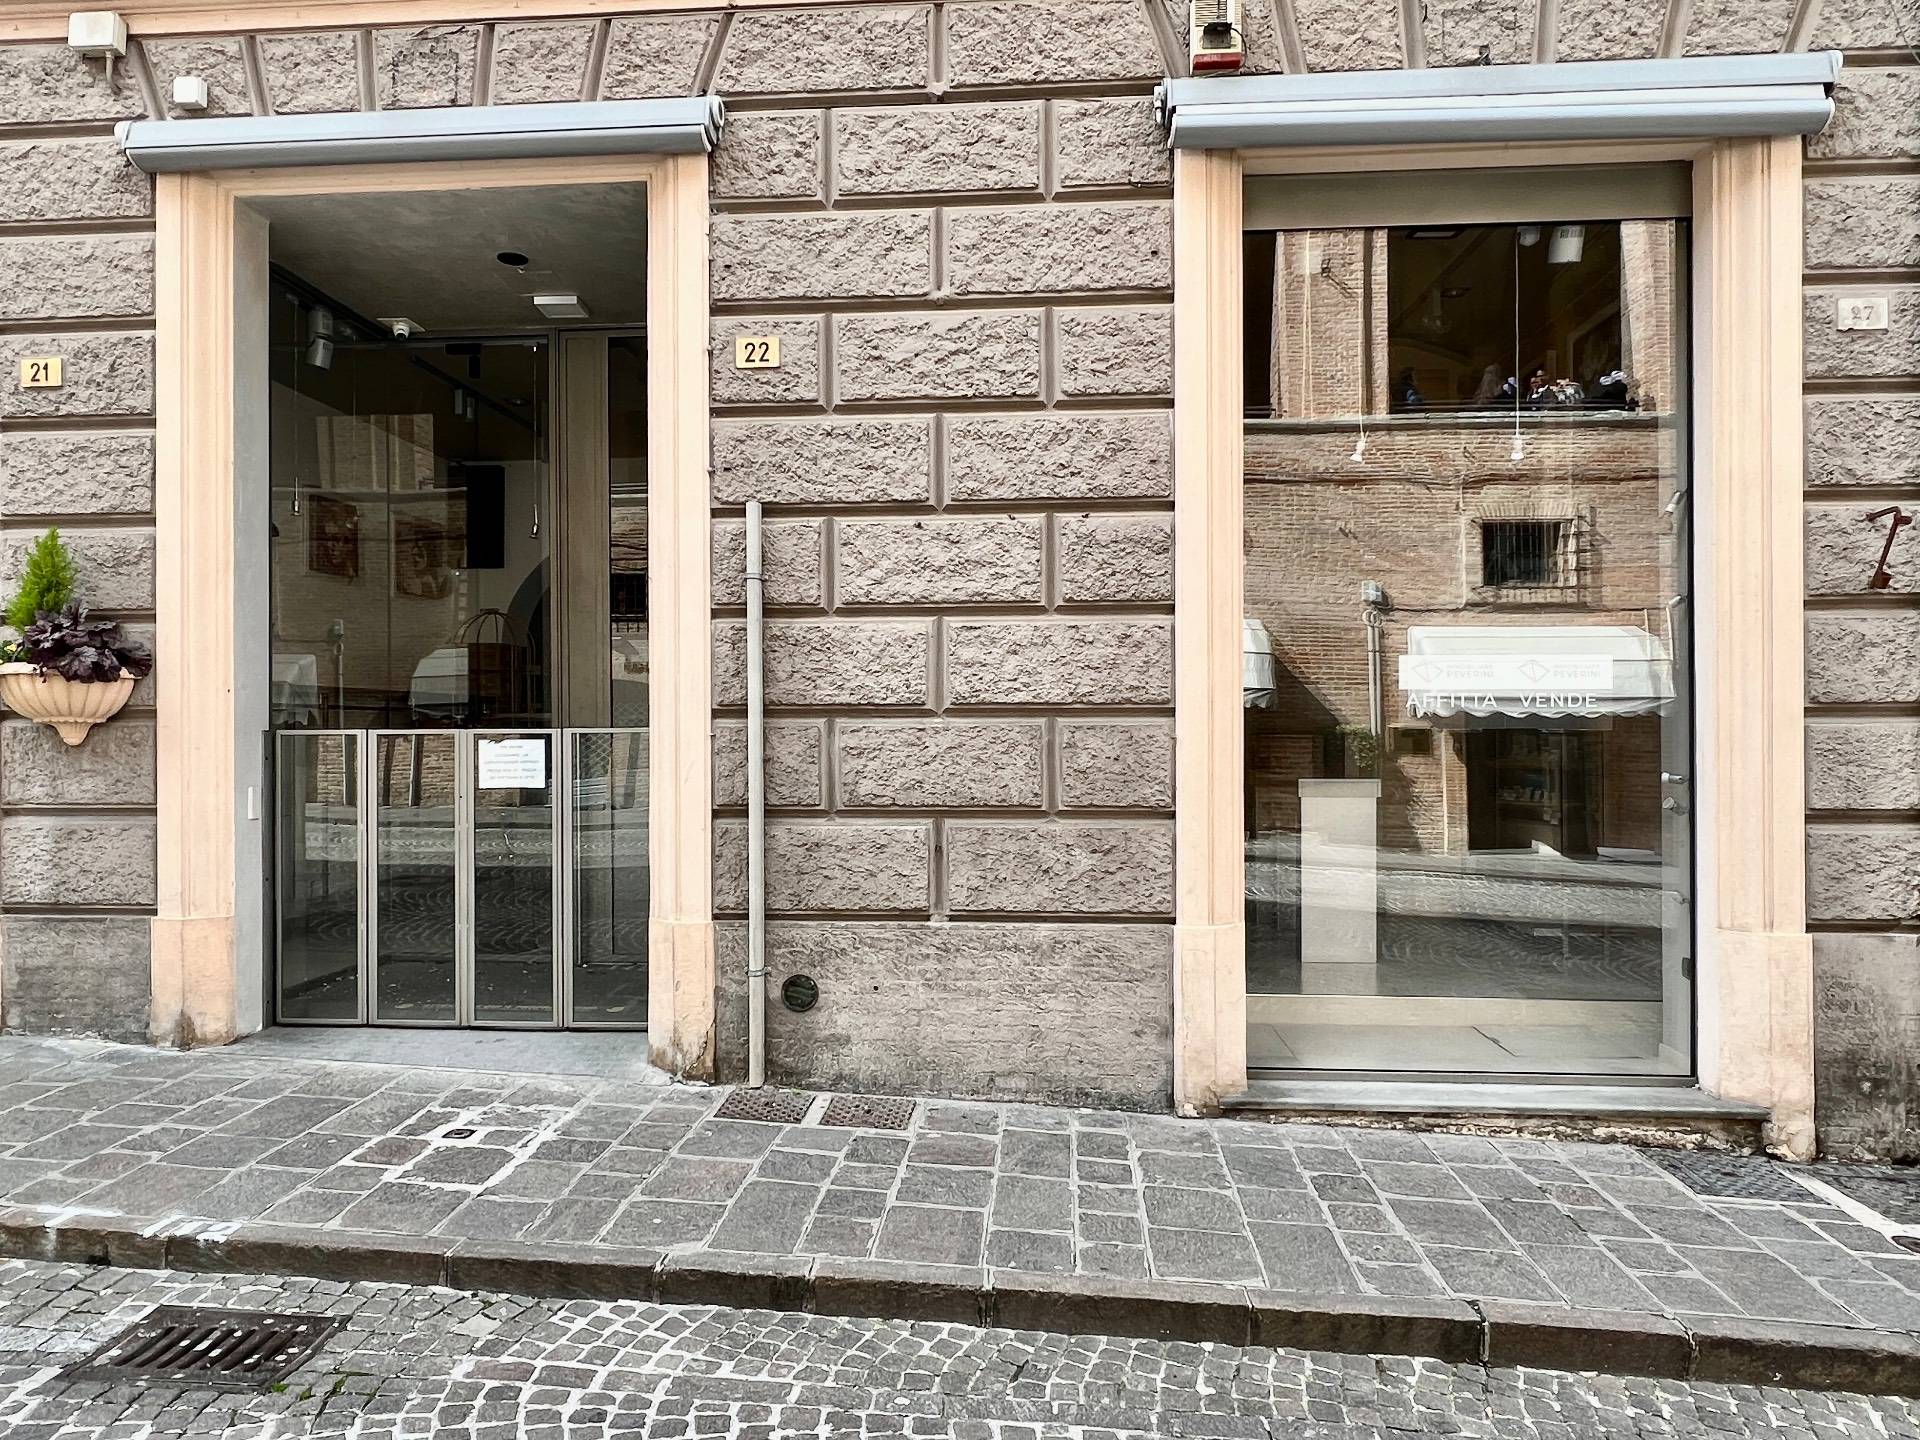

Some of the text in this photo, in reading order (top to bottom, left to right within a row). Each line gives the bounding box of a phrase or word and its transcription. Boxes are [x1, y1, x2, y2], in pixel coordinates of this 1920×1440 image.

[745, 342, 769, 362] 22
[30, 362, 49, 382] 21
[1446, 670, 1494, 678] PEVERINI
[1553, 670, 1600, 678] PEVERINI
[1405, 692, 1597, 708] AFFITTA VENDE
